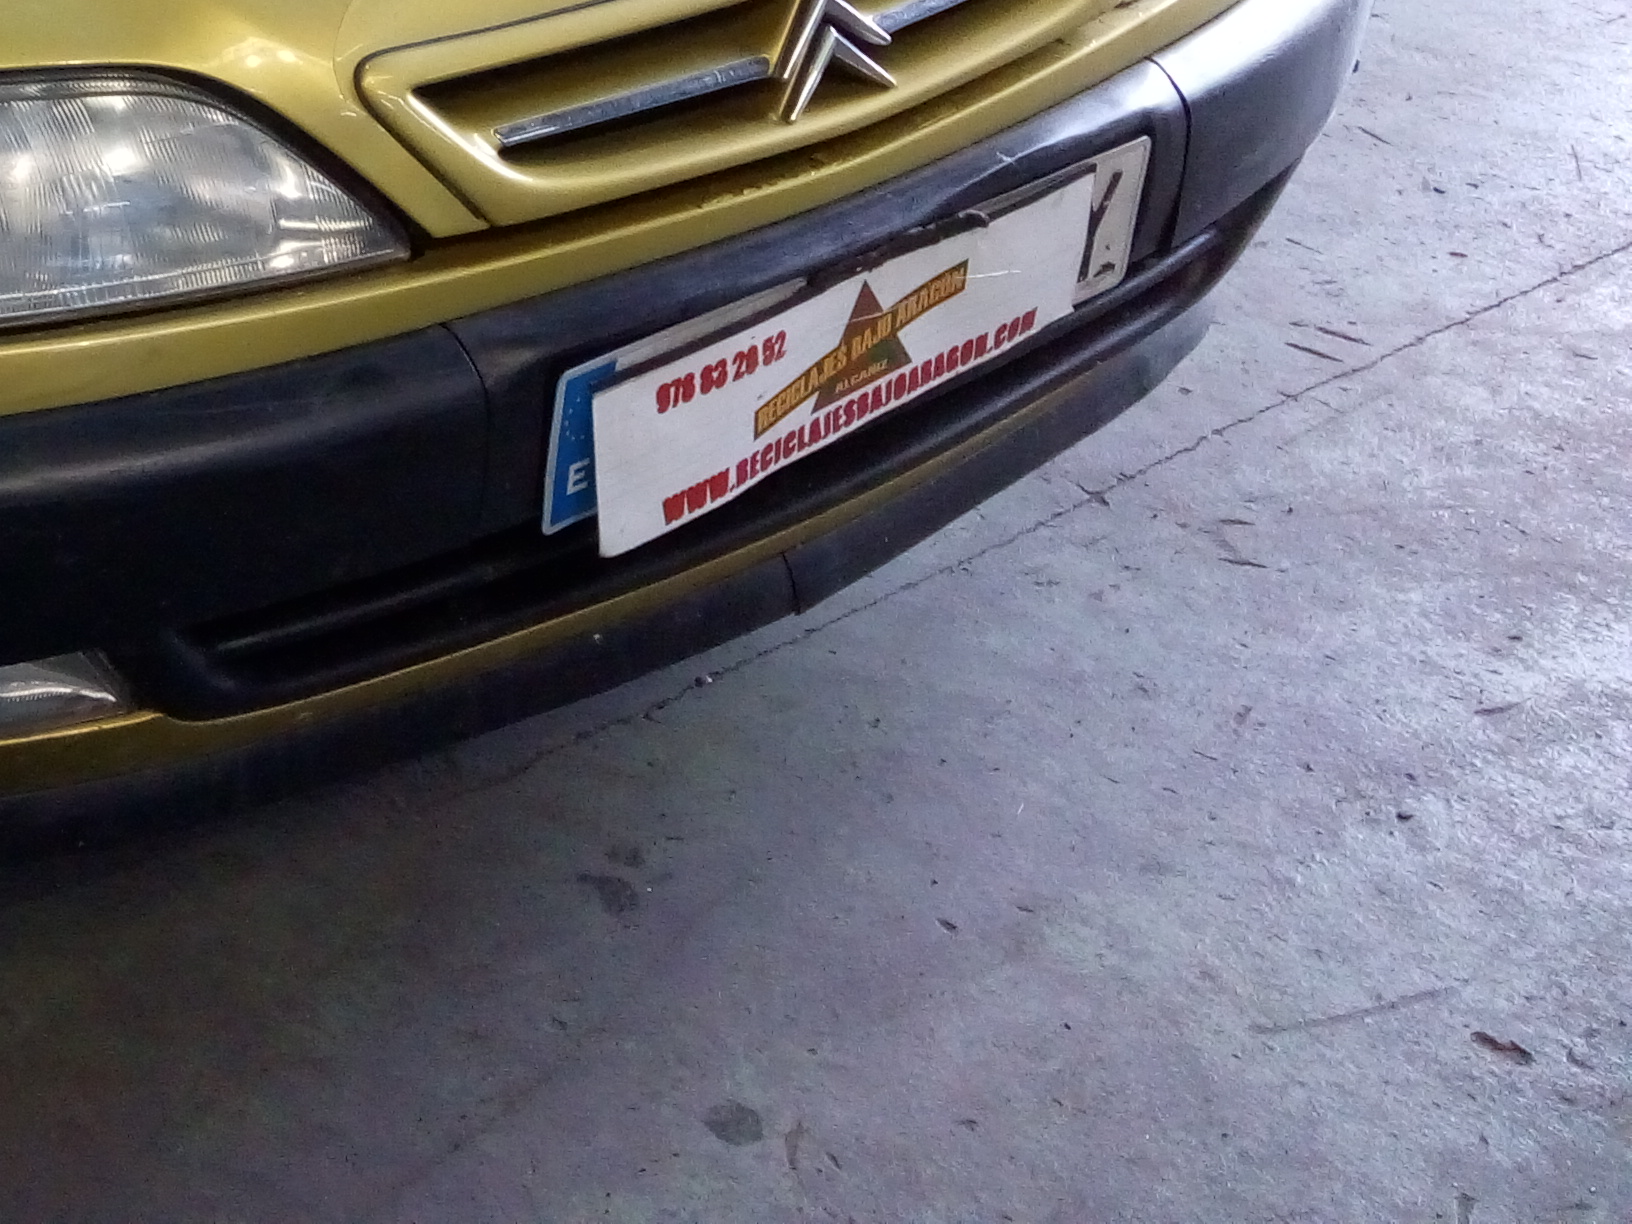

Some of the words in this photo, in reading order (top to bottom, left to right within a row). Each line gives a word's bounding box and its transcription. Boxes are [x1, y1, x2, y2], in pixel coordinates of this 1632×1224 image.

[762, 330, 787, 366] 52
[757, 343, 848, 432] RECICLAJES
[851, 312, 893, 361] BAJO
[566, 457, 590, 496] E
